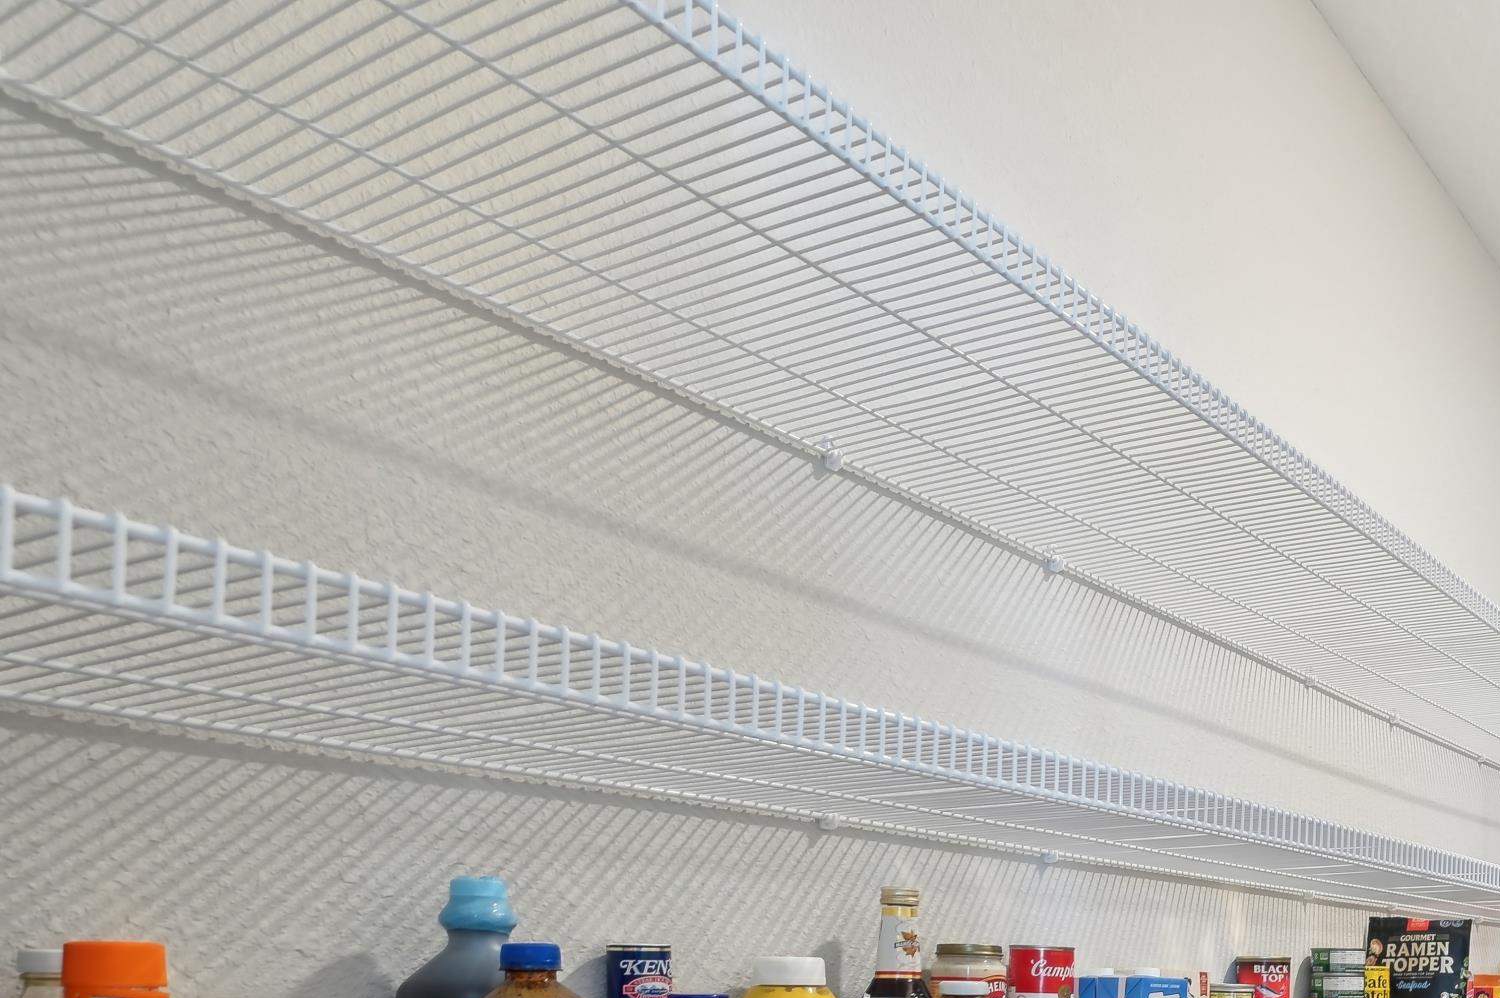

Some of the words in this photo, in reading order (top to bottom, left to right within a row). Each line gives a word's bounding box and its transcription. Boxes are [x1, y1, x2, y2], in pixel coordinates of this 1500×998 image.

[1386, 942, 1450, 957] RAMEN
[1253, 964, 1289, 974] BLACK
[1382, 956, 1454, 974] TOPPER
[1261, 974, 1285, 983] TOP
